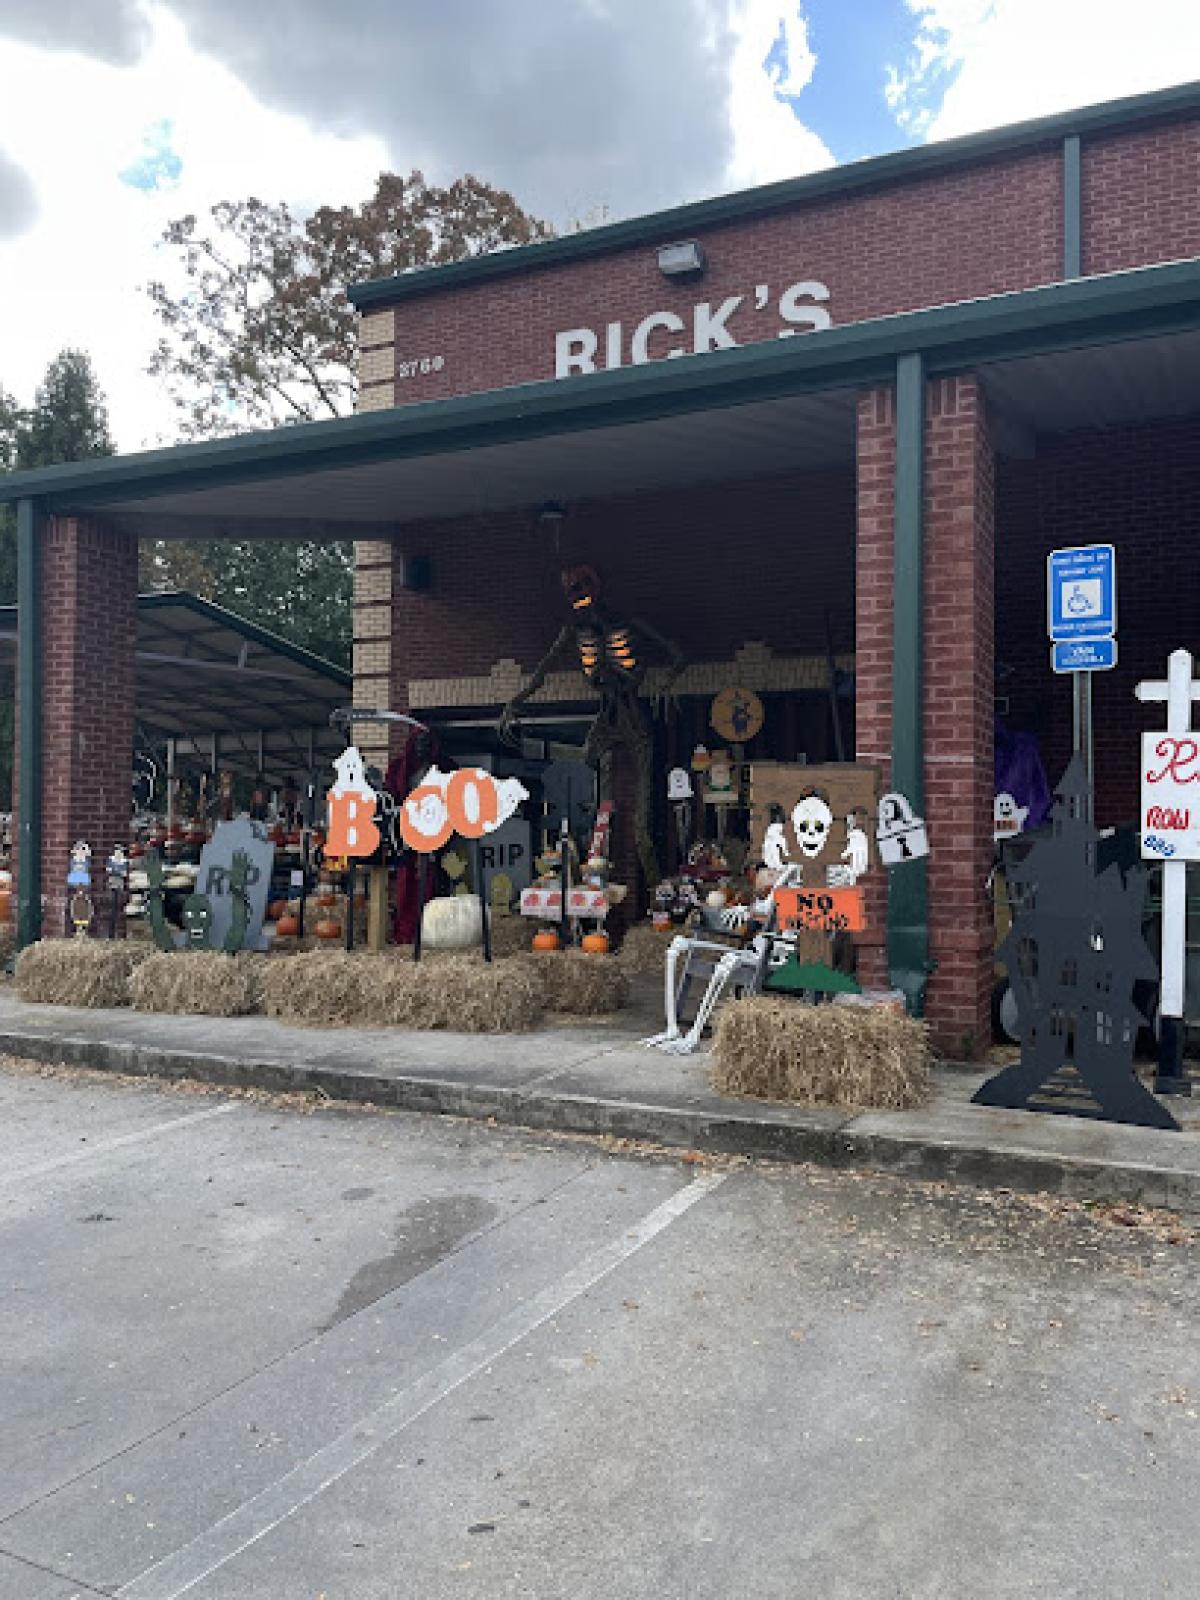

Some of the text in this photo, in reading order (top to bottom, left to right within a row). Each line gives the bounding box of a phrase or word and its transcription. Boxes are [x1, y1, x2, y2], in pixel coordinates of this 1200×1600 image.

[554, 281, 832, 380] RICK'S
[324, 767, 499, 857] BOO
[481, 844, 525, 869] RIP
[206, 864, 261, 895] RP
[796, 893, 833, 913] NO
